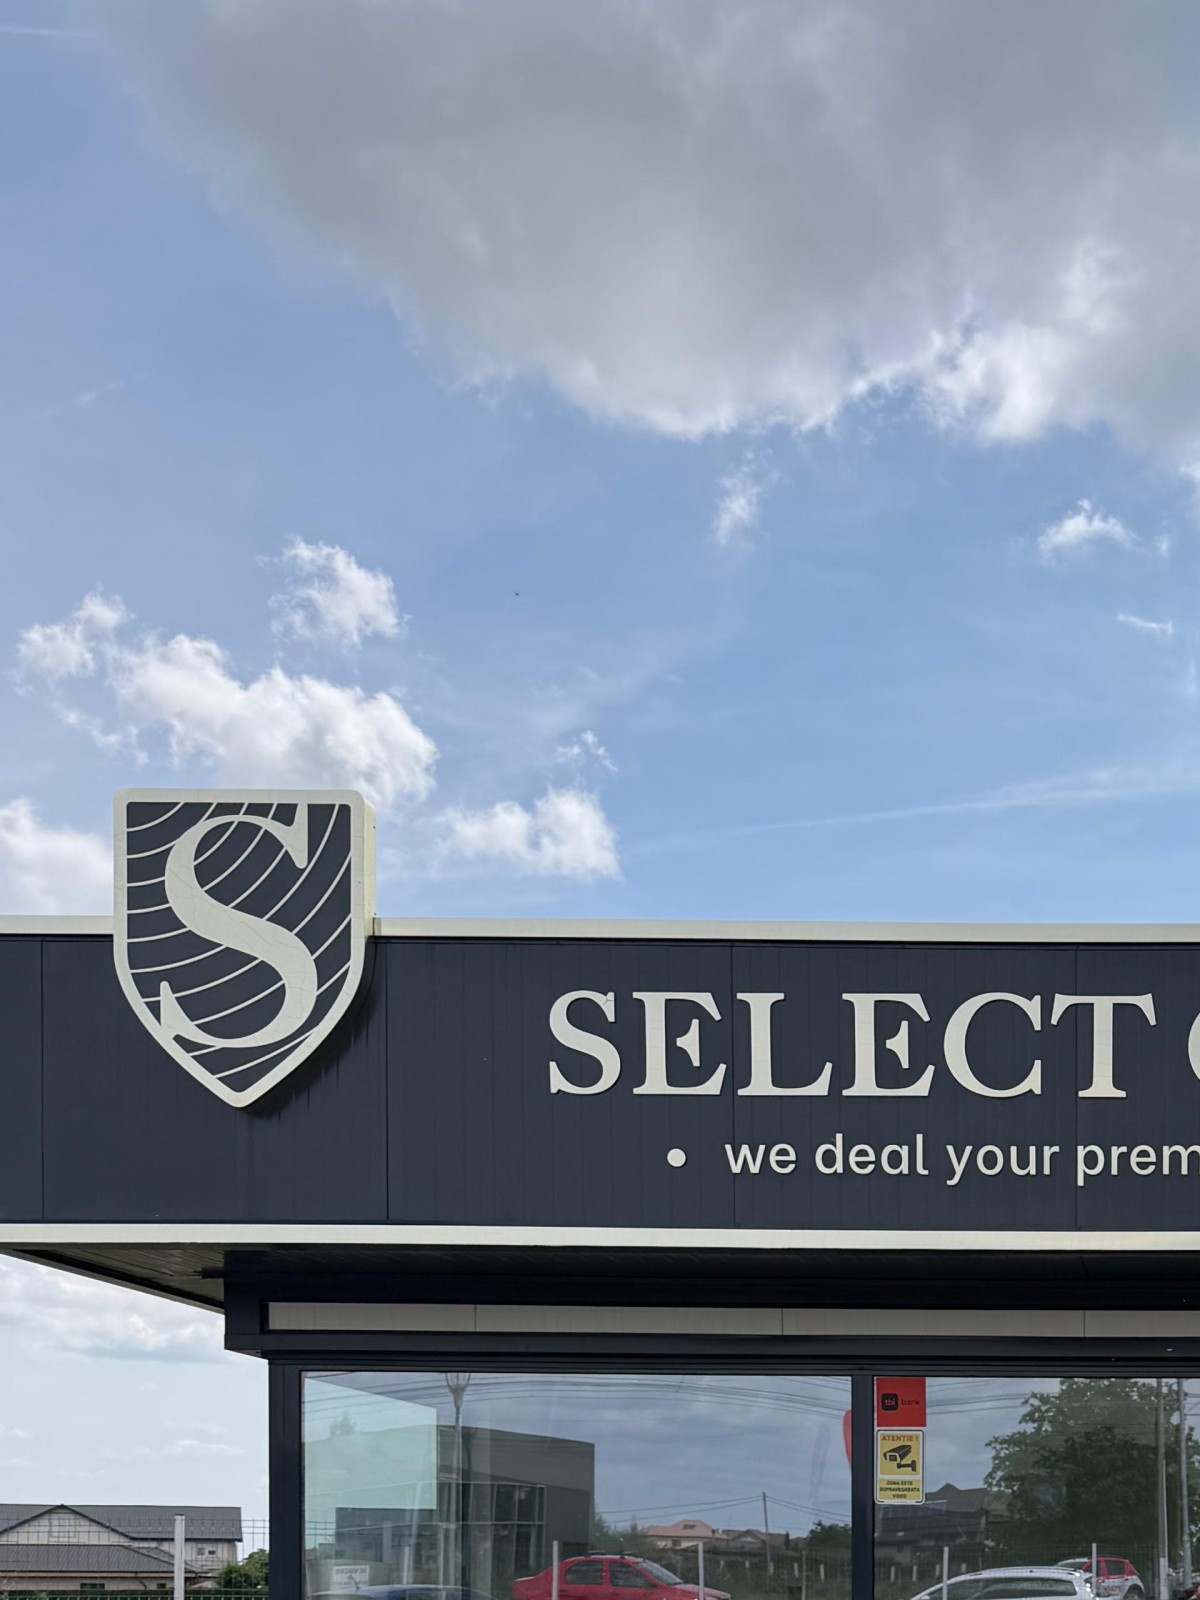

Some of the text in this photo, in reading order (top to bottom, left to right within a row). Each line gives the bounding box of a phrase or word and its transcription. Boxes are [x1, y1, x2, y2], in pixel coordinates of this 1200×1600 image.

[160, 802, 317, 1049] S
[548, 989, 1157, 1099] SELECT
[724, 1142, 797, 1175] we
[814, 1132, 929, 1176] deal
[946, 1143, 1060, 1187] your
[901, 1398, 921, 1406] bank
